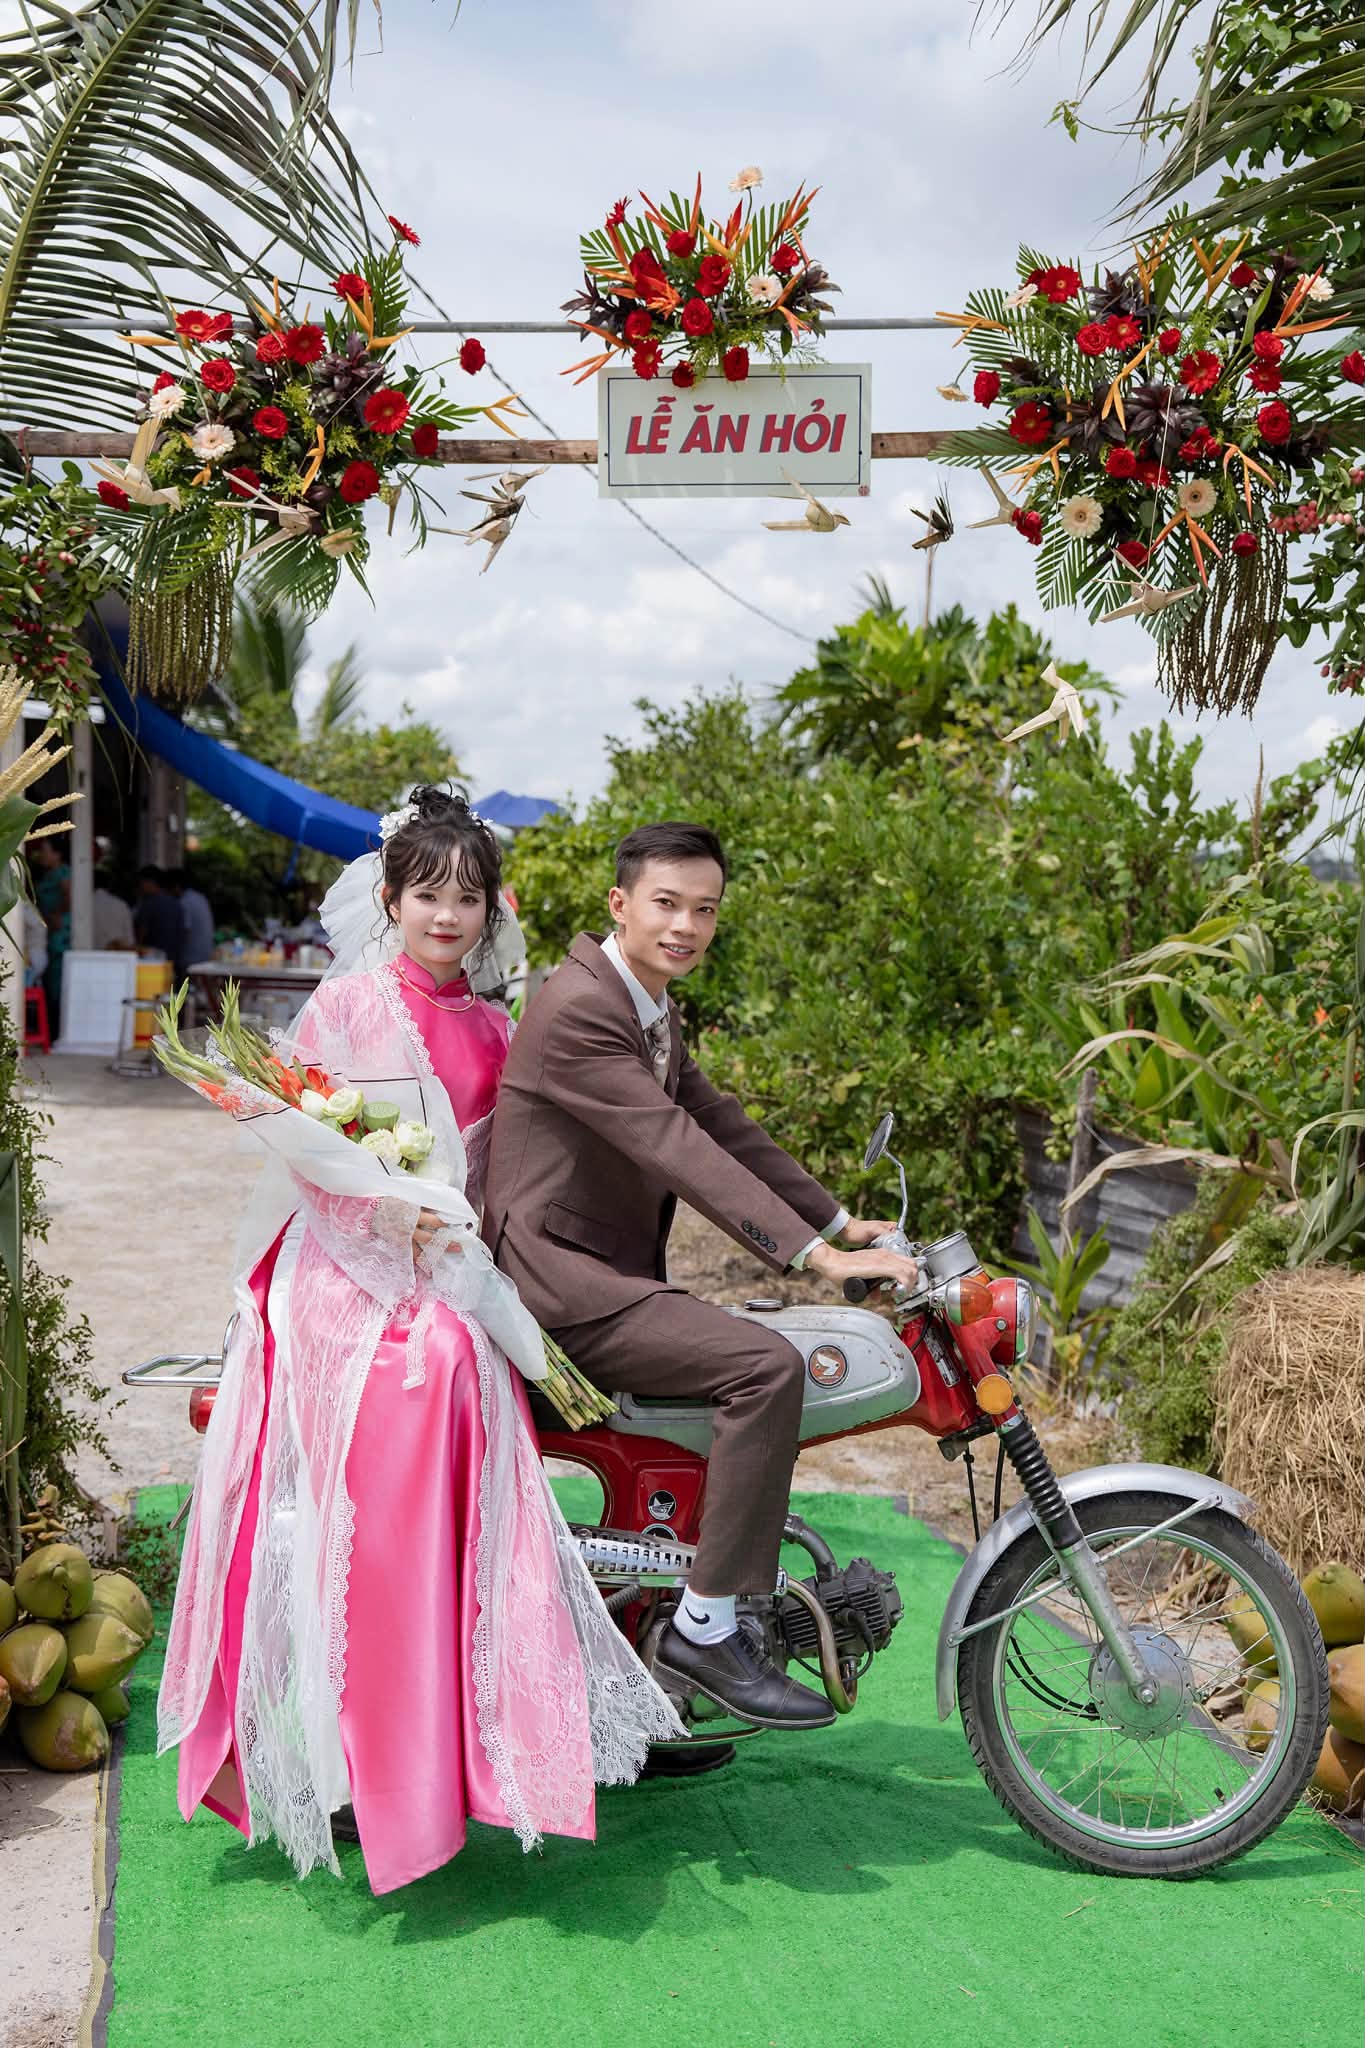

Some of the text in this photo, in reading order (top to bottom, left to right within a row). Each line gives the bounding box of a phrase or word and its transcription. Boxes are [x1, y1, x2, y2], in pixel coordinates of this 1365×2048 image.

[625, 396, 847, 454] LỄ ĂN HỎI
